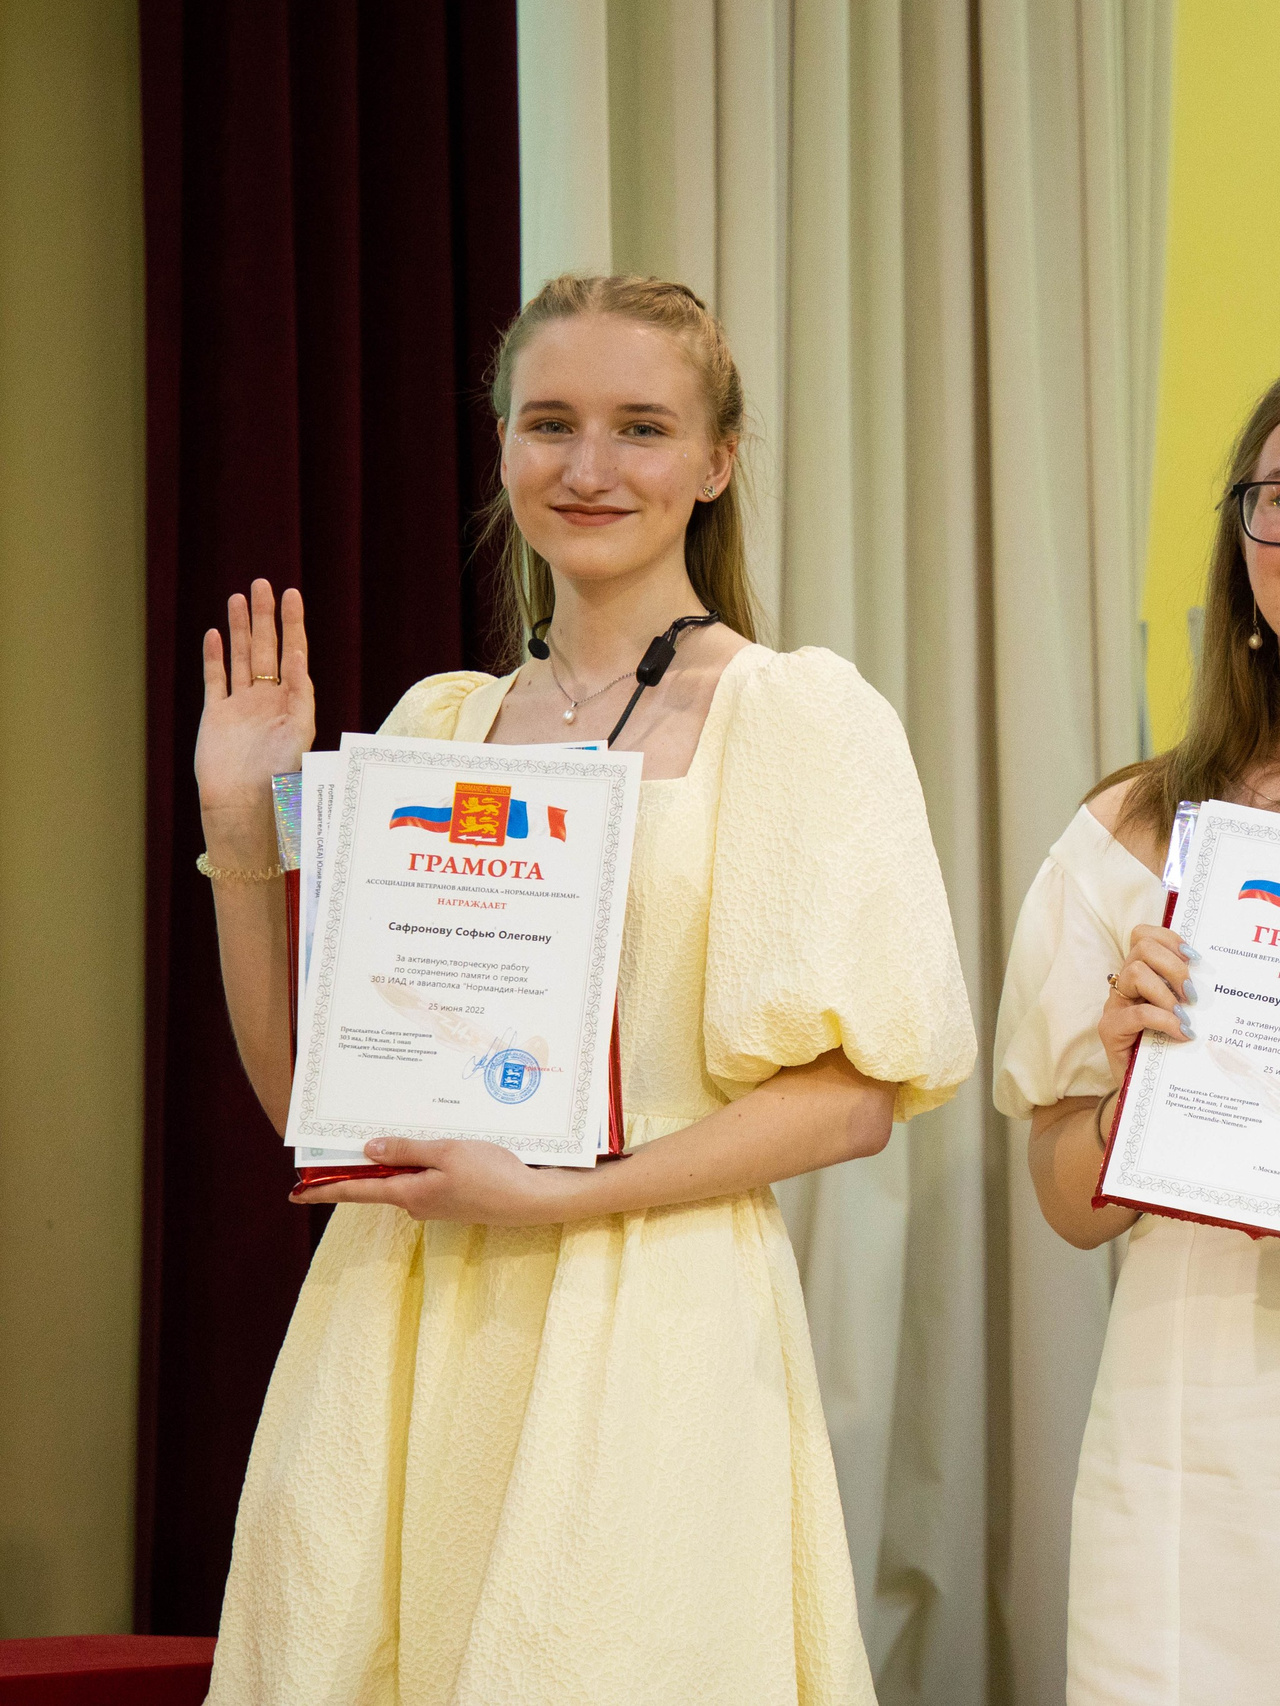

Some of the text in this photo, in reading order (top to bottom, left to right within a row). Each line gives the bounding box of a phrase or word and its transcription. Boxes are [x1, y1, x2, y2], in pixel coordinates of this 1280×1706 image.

[316, 784, 324, 836] Преподаватель
[408, 853, 544, 880] ГРАМОТА
[366, 879, 415, 888] АССОЦИАЦИЯ
[416, 882, 456, 891] ВЕТЕРАНОВ
[457, 885, 499, 894] АВИАПОЛКА
[437, 898, 507, 910] НАГРАЖДАЕТ
[388, 921, 552, 944] Сафронову Софью Олеговну
[1209, 945, 1258, 959] АССОЦИАЦИЯ
[395, 954, 406, 962] За
[500, 963, 530, 973] работу
[370, 975, 385, 984] 303
[387, 977, 407, 986] ИАД
[417, 980, 460, 989] авиаполка
[407, 968, 459, 978] сохранению
[460, 972, 490, 980] памяти
[500, 975, 528, 984] героях
[428, 1003, 438, 1011] 25
[465, 1005, 485, 1014] 2022
[1235, 1016, 1245, 1025] За
[340, 1026, 380, 1034] Председатель
[338, 1042, 370, 1050] Президент
[371, 1045, 406, 1053] Ассоциации
[1208, 1034, 1223, 1043] 303
[1224, 1038, 1244, 1048] ИАД
[1263, 1066, 1274, 1074] 25
[1169, 1084, 1260, 1107] Председатель Совета ветеранов
[1165, 1099, 1263, 1124] Президент Ассоциации ветеранов
[1258, 1166, 1280, 1175] Москва
